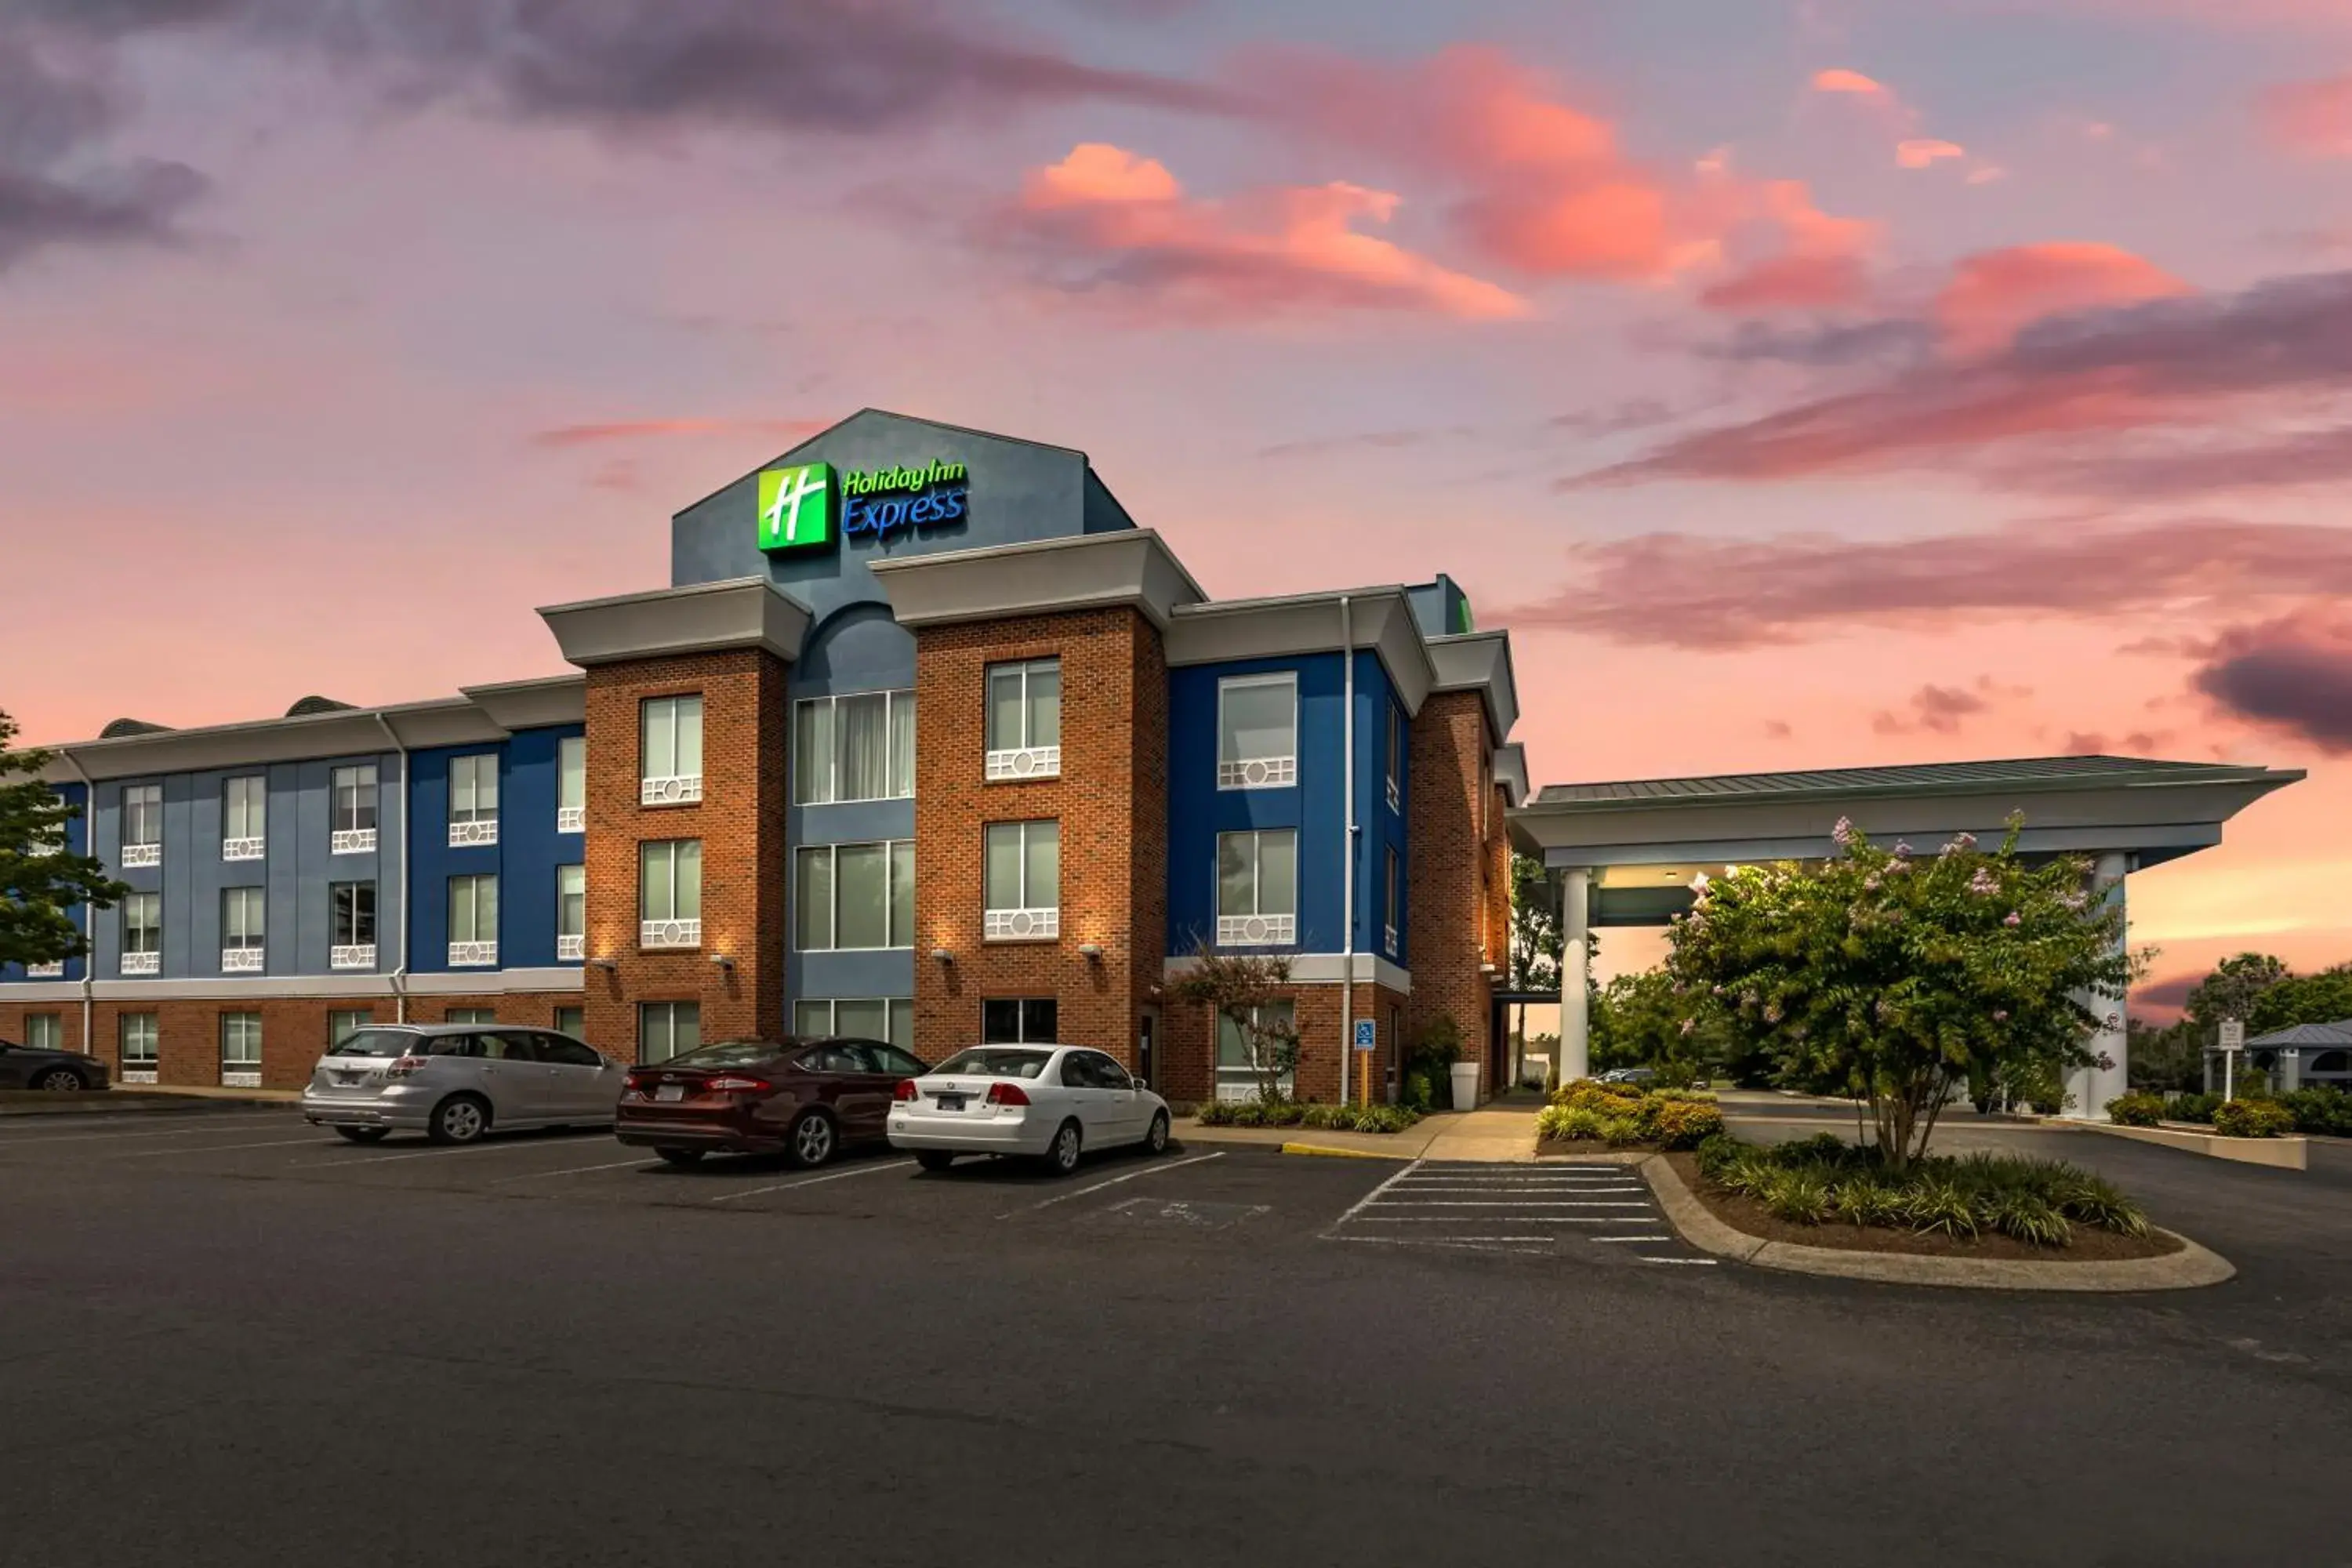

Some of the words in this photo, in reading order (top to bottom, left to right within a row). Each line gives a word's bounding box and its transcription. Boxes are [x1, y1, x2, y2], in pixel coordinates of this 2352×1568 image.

[842, 464, 926, 496] Holiday
[927, 457, 964, 482] Inn
[843, 489, 965, 540] Express
